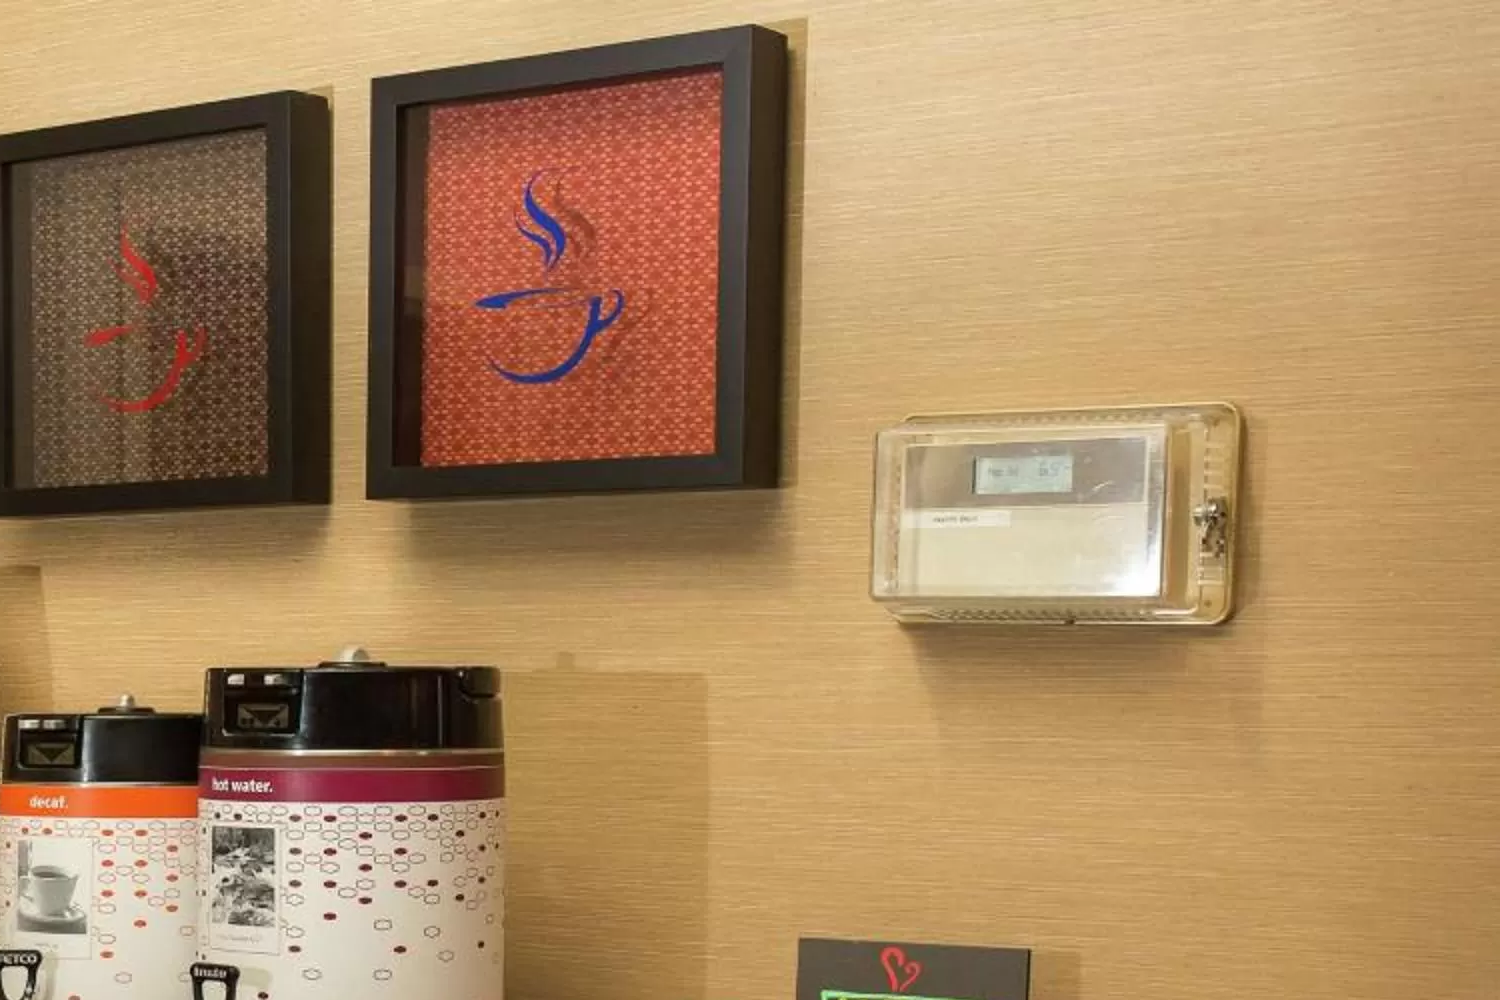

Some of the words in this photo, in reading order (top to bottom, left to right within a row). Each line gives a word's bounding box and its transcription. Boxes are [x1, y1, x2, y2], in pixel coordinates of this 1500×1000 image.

[212, 777, 229, 791] hot
[232, 780, 273, 793] water.
[29, 795, 69, 809] decaf.
